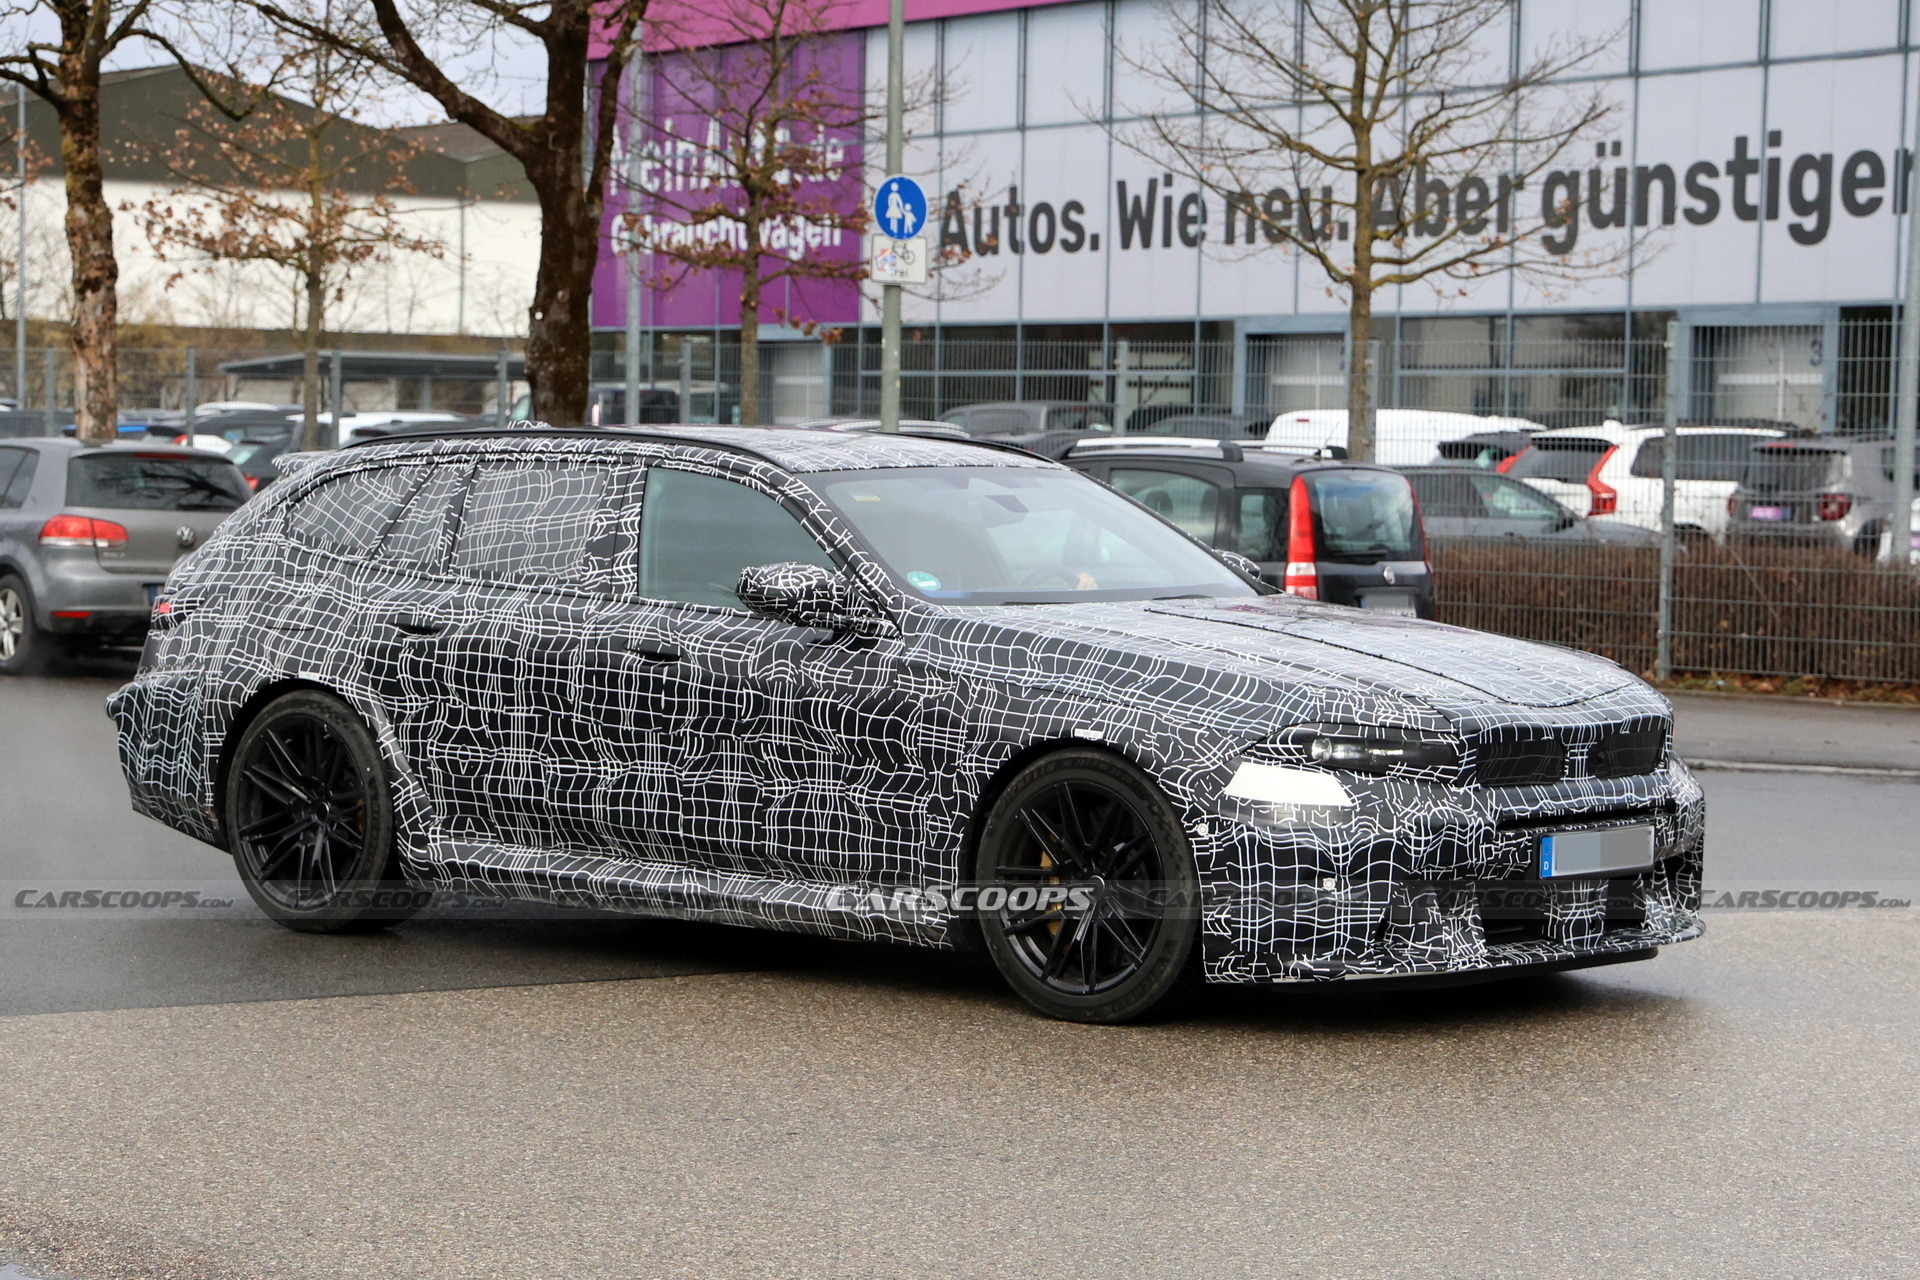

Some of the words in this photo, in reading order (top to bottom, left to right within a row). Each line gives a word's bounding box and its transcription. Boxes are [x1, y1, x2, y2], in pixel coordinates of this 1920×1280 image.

[940, 185, 1099, 255] Autos.
[1117, 173, 1207, 249] Wie
[1224, 185, 1349, 243] neu.
[1371, 159, 1524, 237] Aber
[1541, 131, 1914, 255] günstiger
[1543, 861, 1549, 870] D
